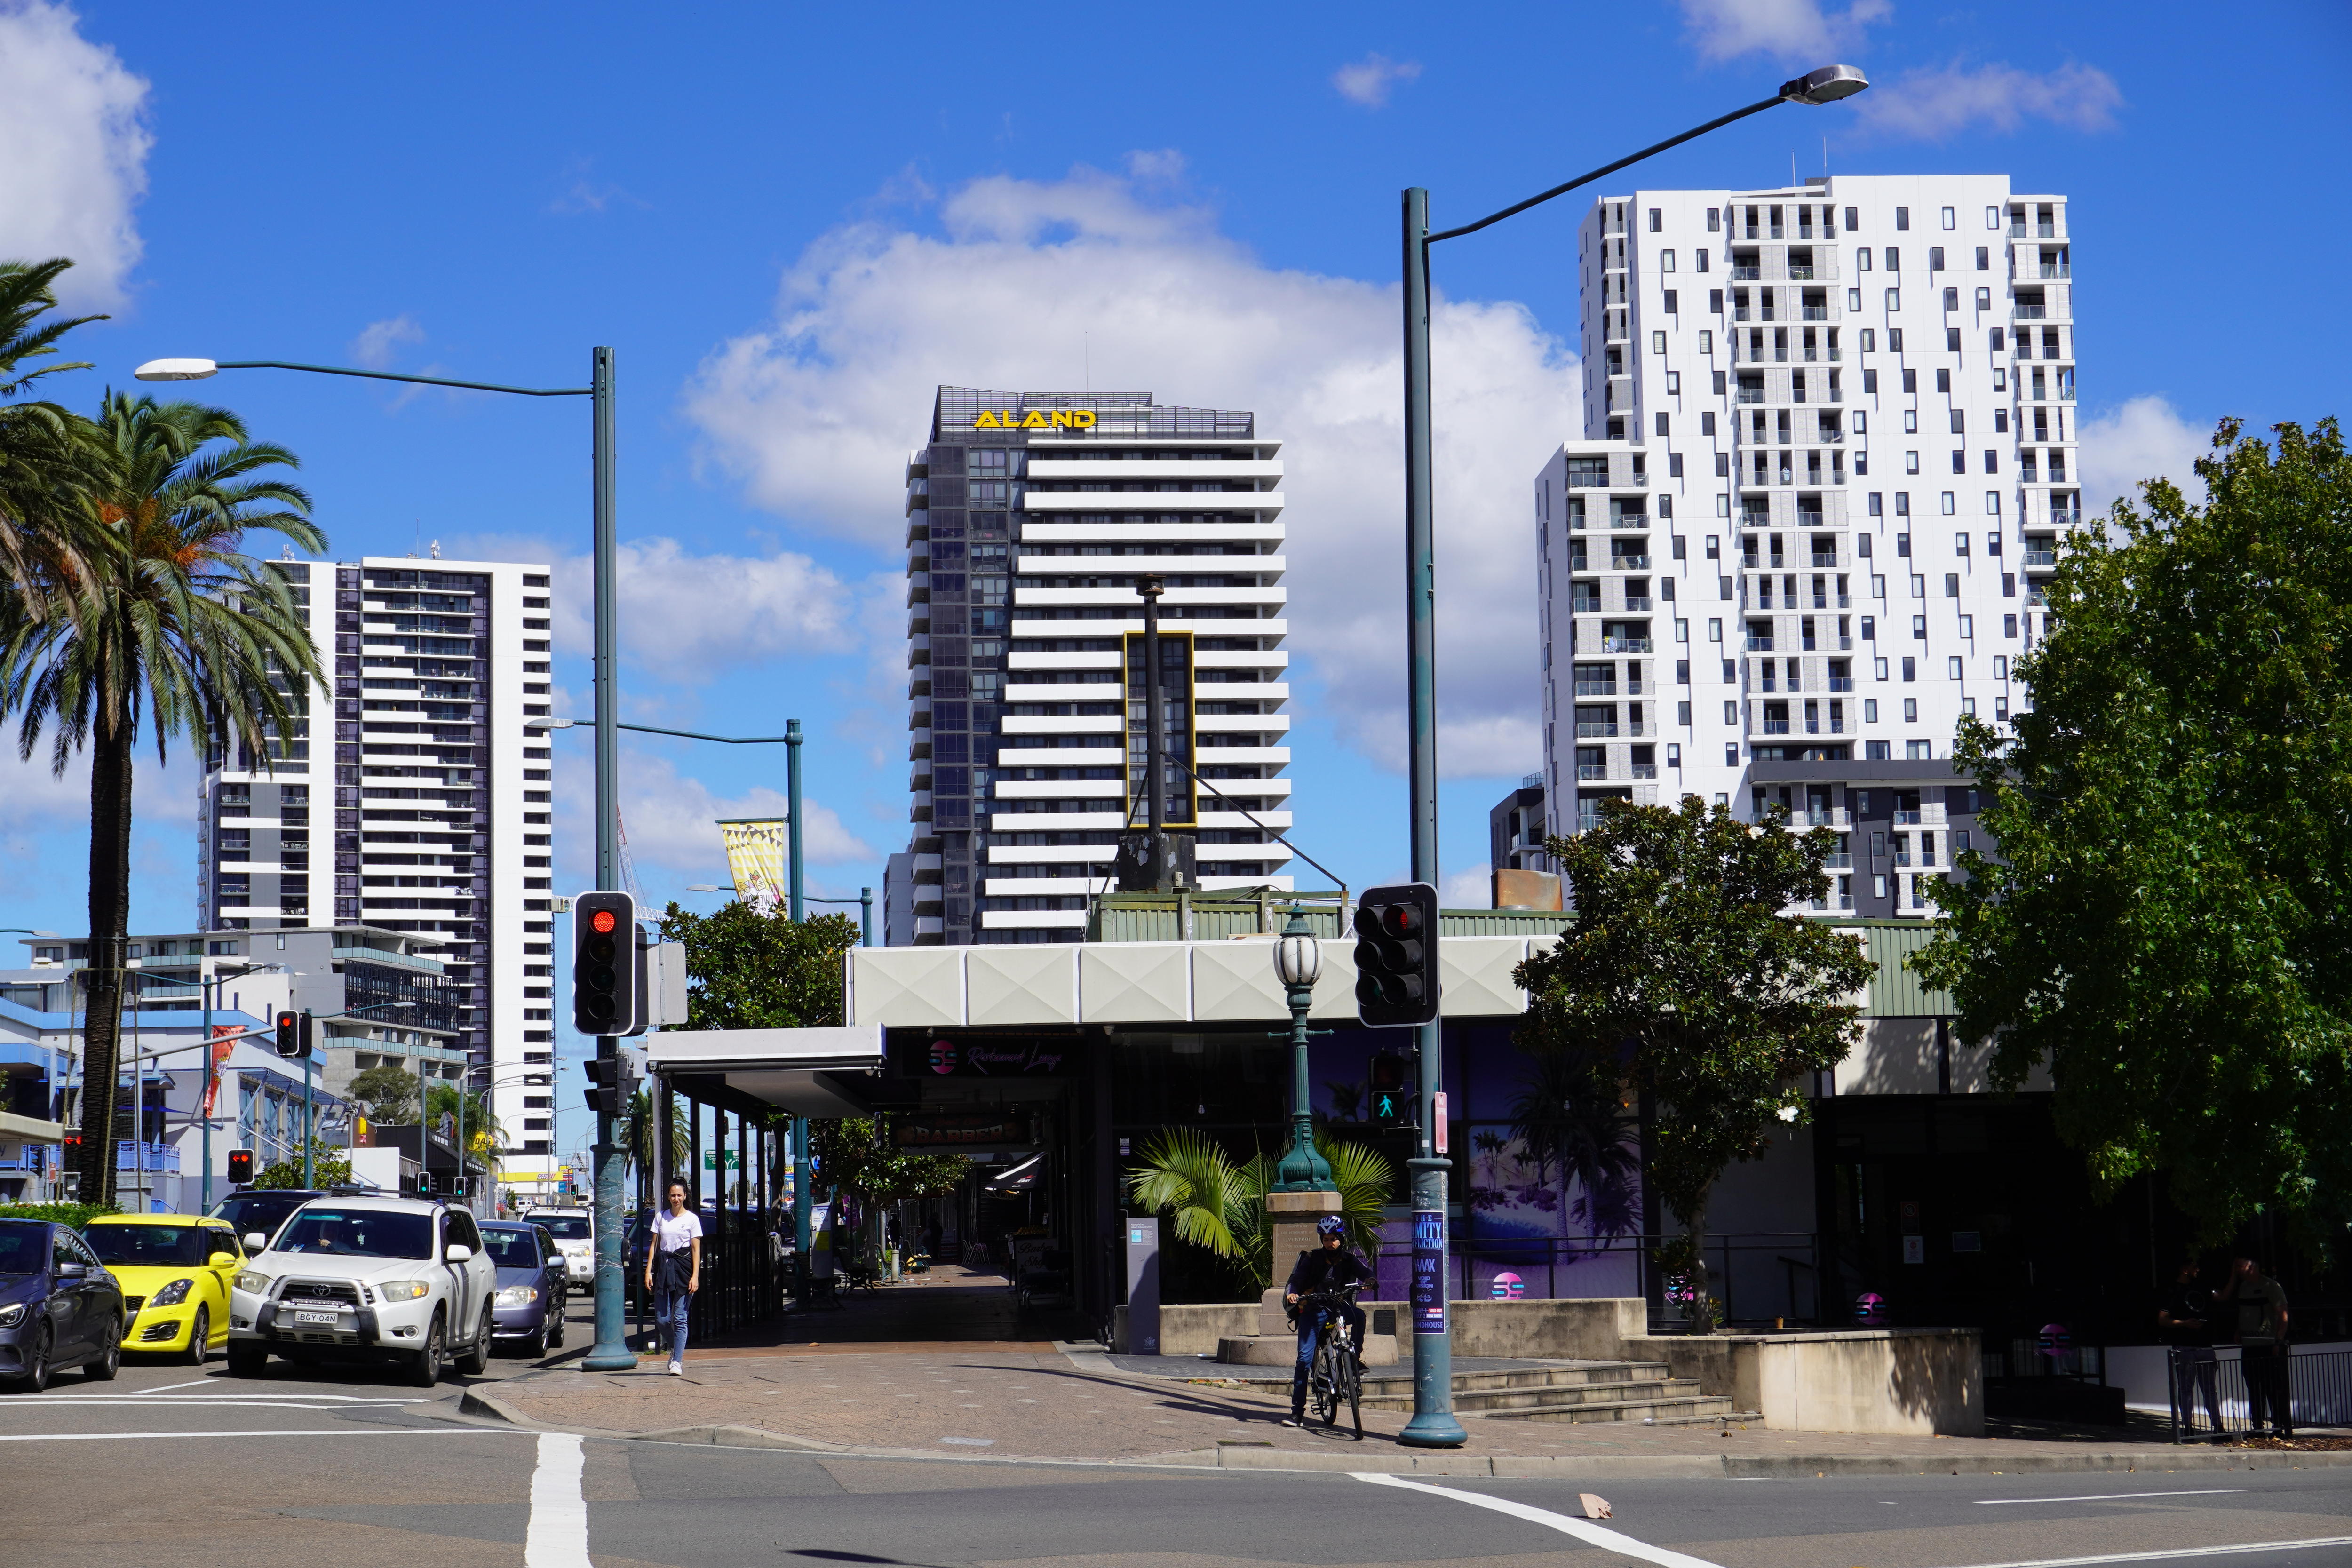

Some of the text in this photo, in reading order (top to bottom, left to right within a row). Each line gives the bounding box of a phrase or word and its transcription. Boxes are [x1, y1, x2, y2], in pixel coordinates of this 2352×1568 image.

[974, 410, 1097, 428] ALAND
[967, 1046, 1027, 1075] Restaurant
[1023, 1040, 1062, 1073] Lounge
[915, 1125, 1003, 1142] BARBER
[1412, 1222, 1442, 1239] AMITY
